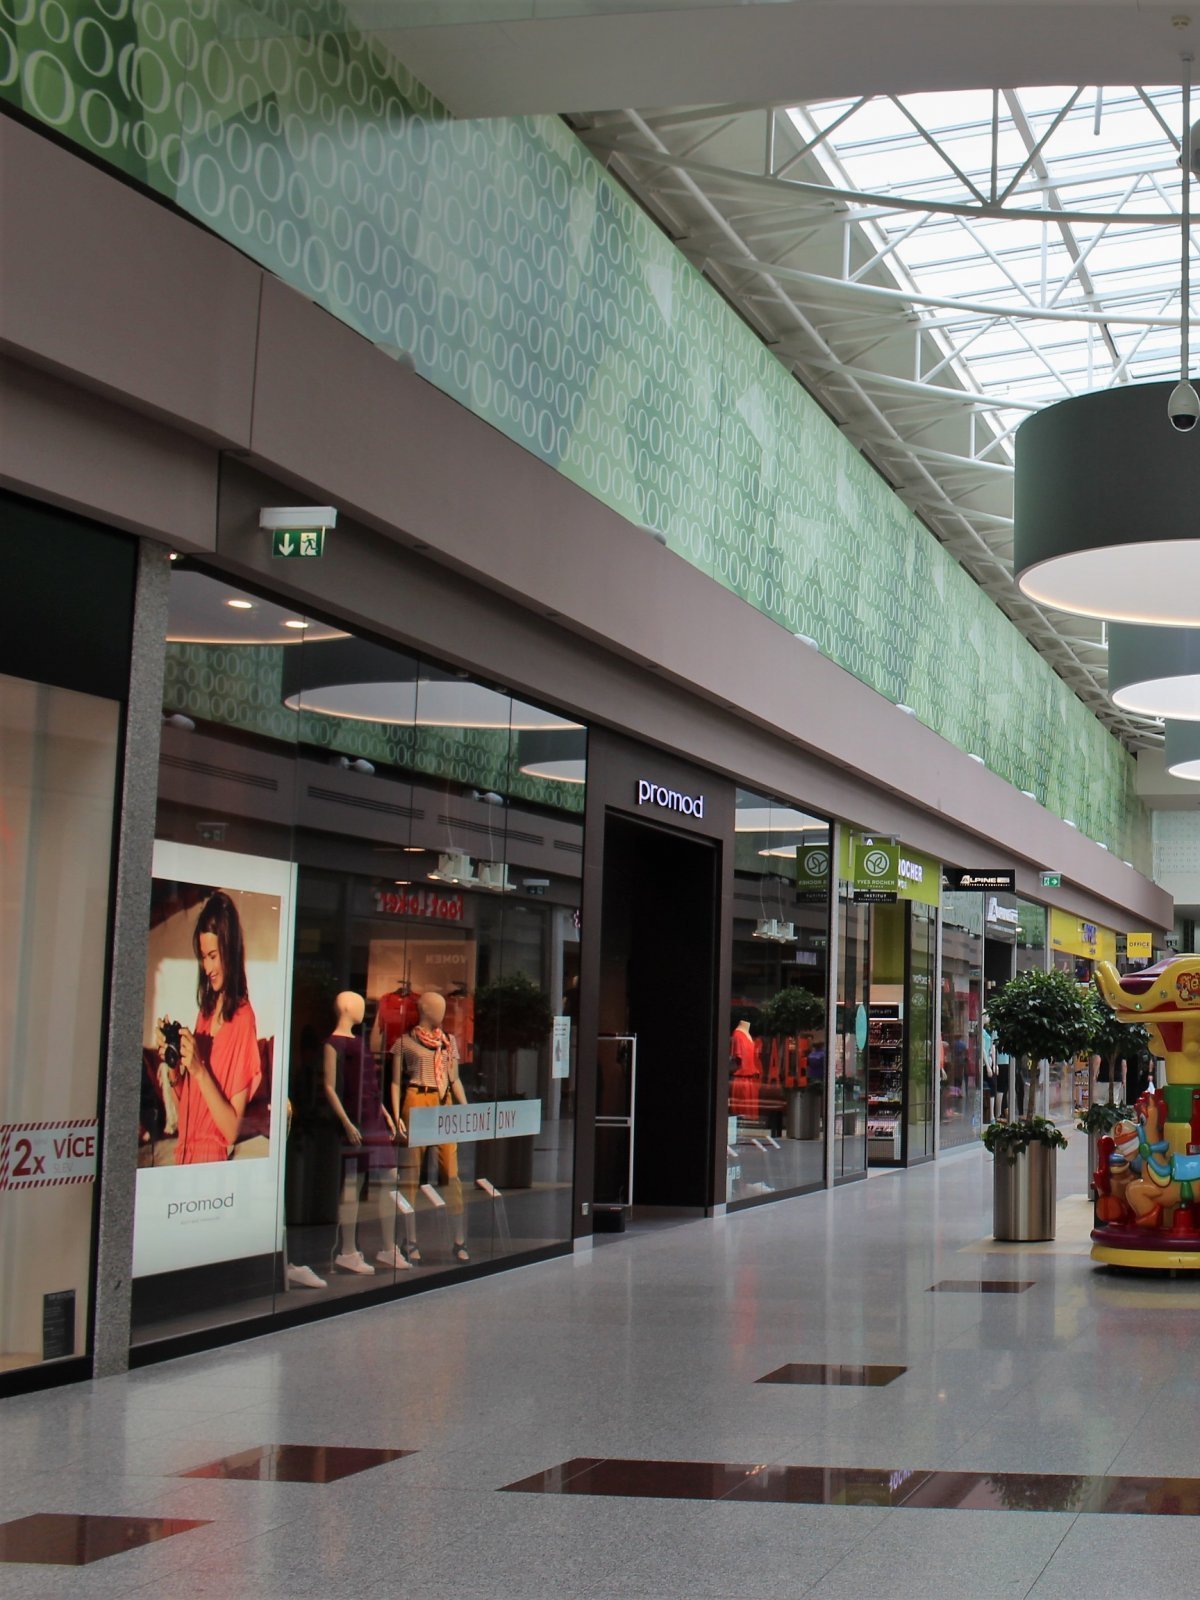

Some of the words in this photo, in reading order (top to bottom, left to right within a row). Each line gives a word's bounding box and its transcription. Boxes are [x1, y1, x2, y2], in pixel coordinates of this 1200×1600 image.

[638, 779, 704, 819] promod
[960, 874, 997, 884] ALPINE
[437, 1106, 492, 1136] POSLEDNÍ
[498, 1110, 517, 1130] DNY
[12, 1138, 46, 1177] 2x
[53, 1132, 96, 1160] VÍCE
[167, 1192, 235, 1220] promod
